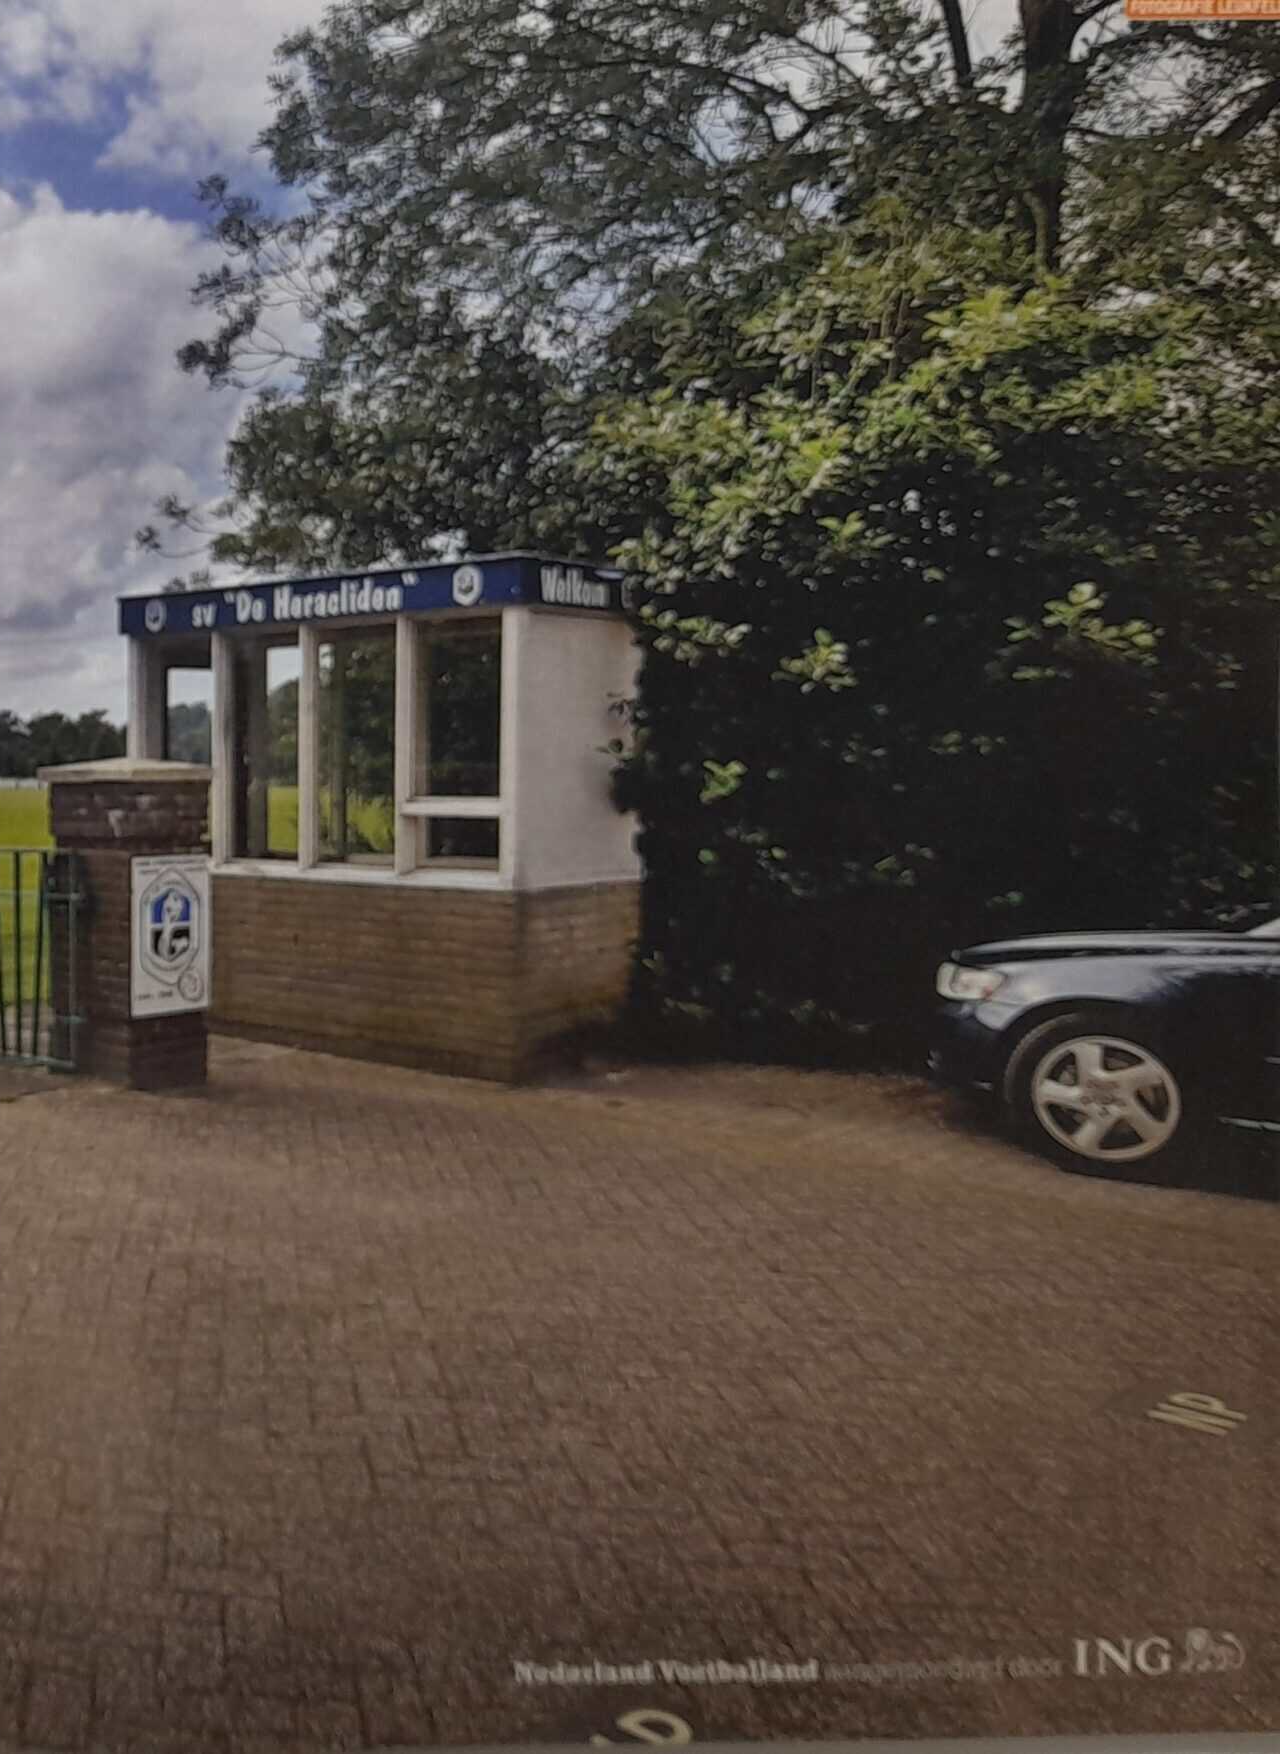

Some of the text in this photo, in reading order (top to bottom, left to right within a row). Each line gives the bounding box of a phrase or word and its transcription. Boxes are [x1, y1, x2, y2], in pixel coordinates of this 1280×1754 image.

[192, 602, 217, 628] sv
[540, 566, 609, 608] Welkom
[514, 1659, 652, 1685] Nederland
[659, 1657, 819, 1686] Voetballand
[1072, 1635, 1174, 1676] ING
